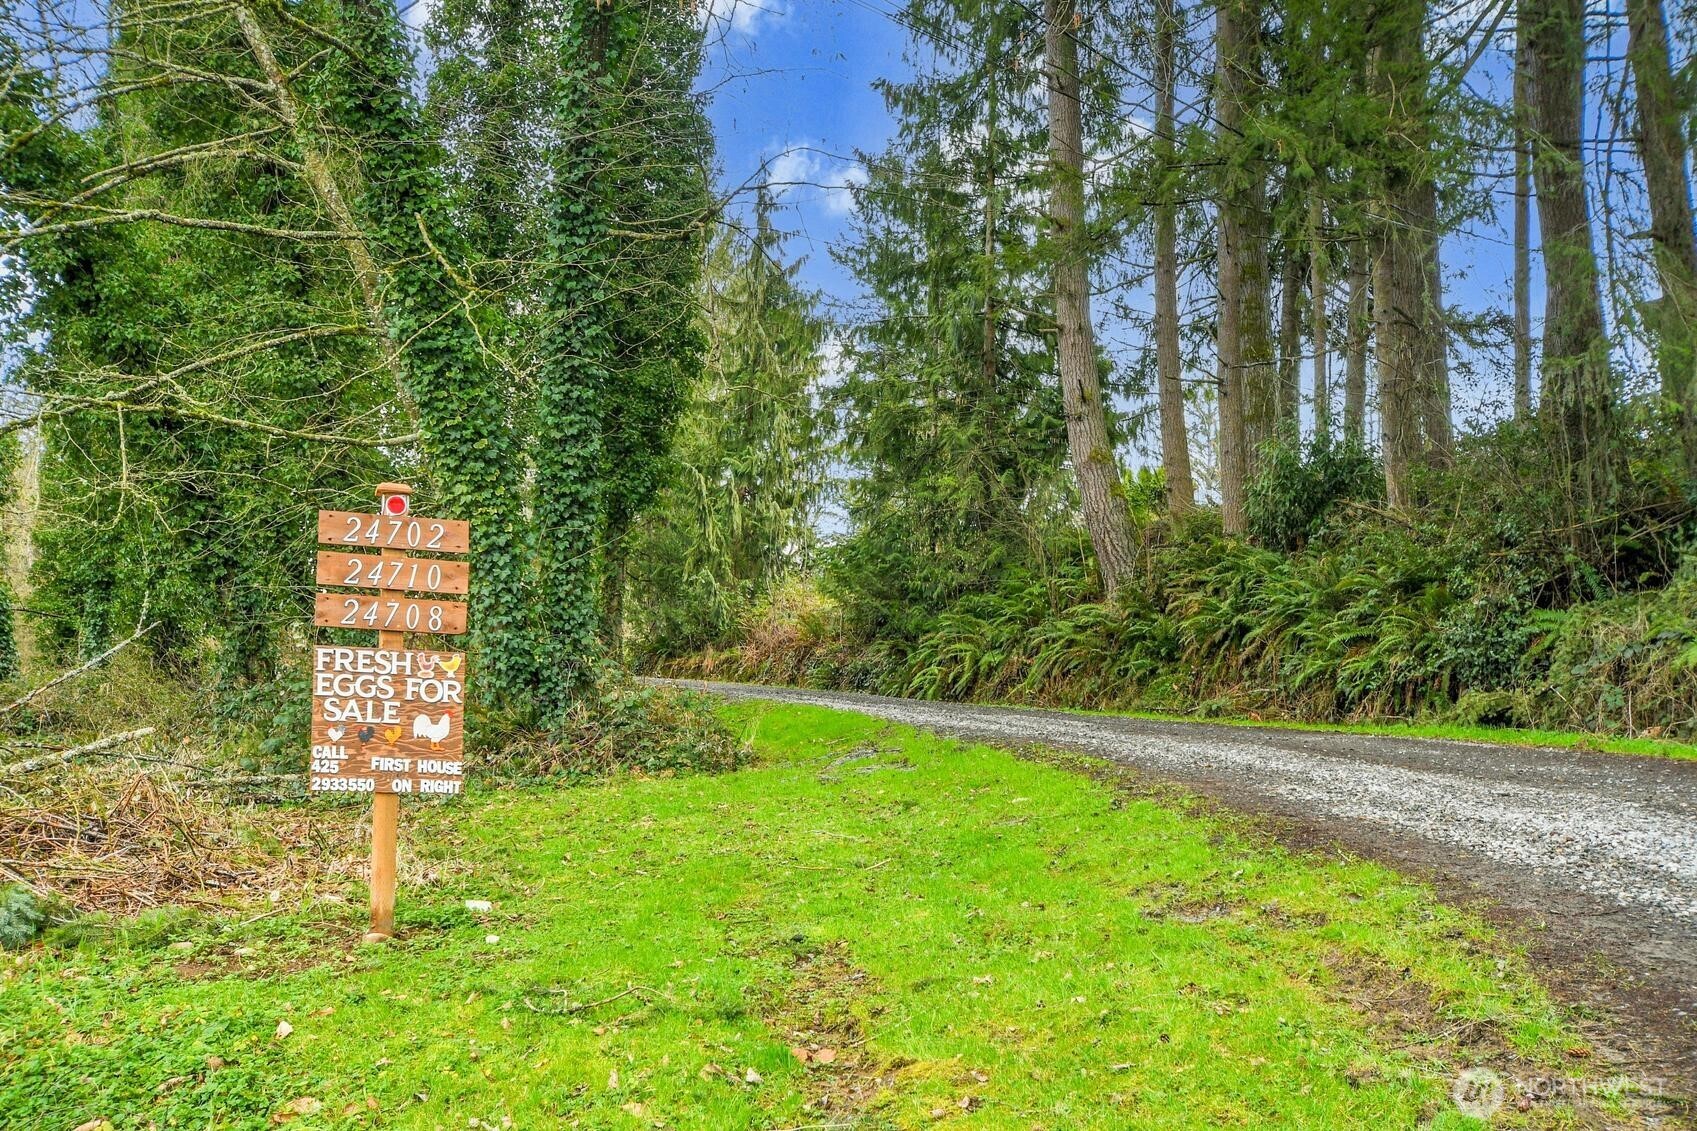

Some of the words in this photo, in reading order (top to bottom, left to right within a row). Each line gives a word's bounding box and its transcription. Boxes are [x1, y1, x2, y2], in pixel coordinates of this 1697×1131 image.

[343, 516, 445, 549] 24702
[343, 558, 441, 590] 24710
[340, 599, 442, 631] 24708
[315, 648, 414, 675] FRESH
[314, 673, 395, 699] EGGS
[405, 677, 462, 703] FOR
[323, 698, 400, 724] SALE
[312, 745, 348, 759] CALL
[311, 759, 339, 773] 425
[371, 757, 412, 772] FIRST
[417, 760, 463, 775] HOUSE
[311, 777, 375, 792] 2933550
[391, 779, 412, 792] ON
[420, 779, 462, 794] RIGHT
